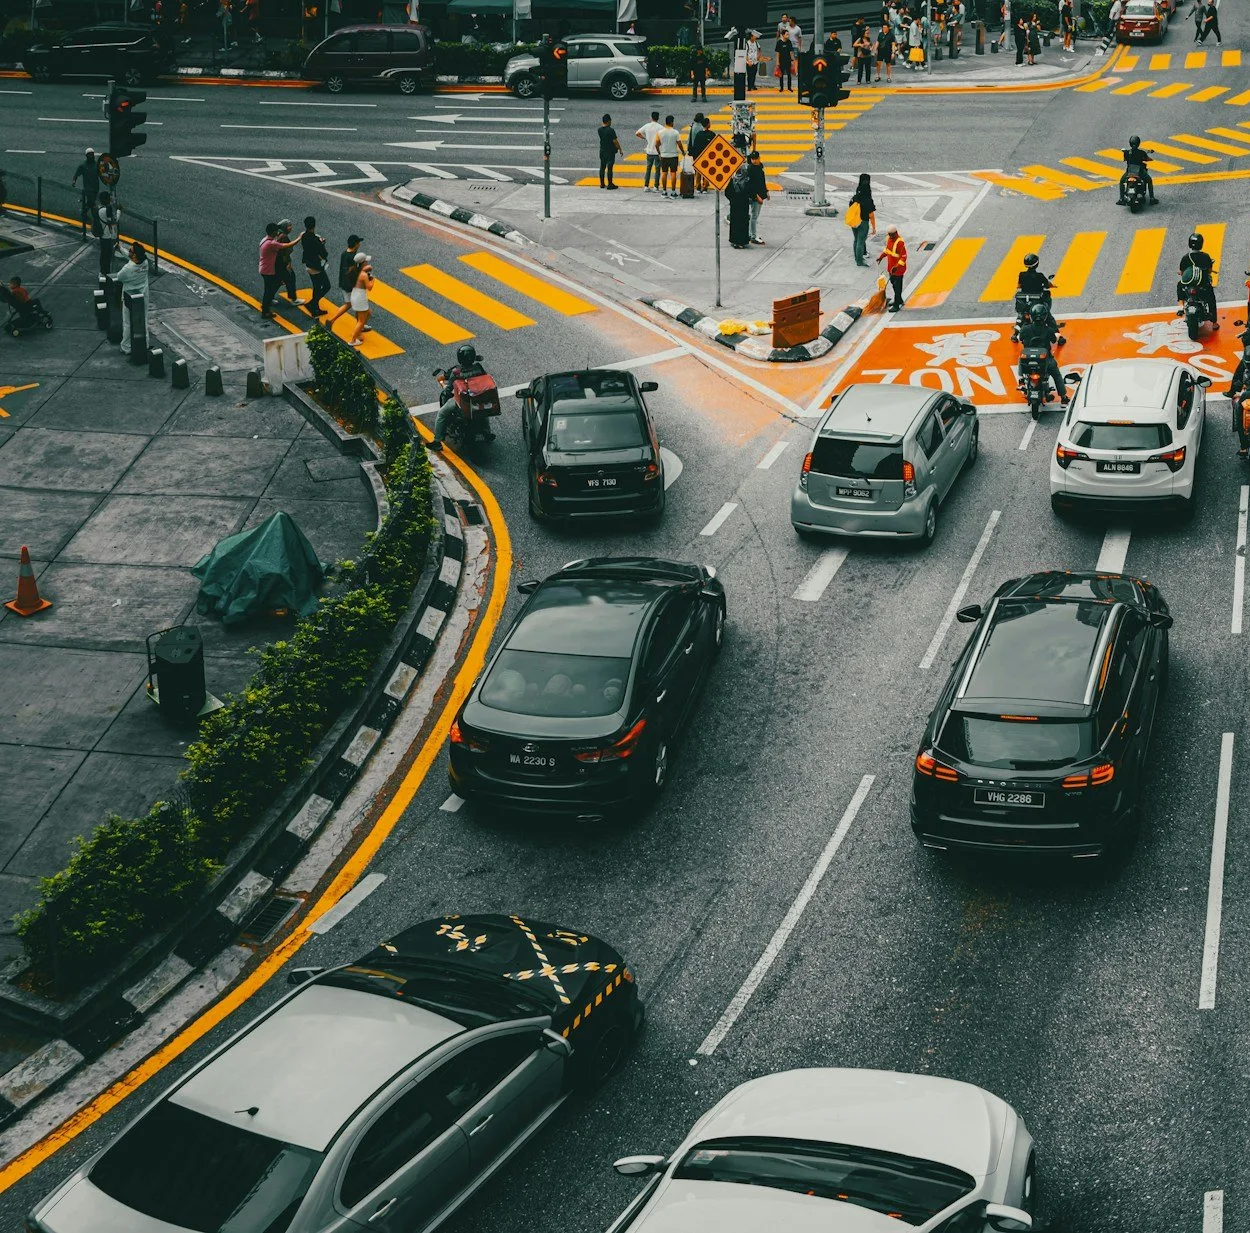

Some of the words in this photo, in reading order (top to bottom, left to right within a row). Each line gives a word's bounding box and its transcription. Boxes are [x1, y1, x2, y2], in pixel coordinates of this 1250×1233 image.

[509, 754, 521, 764] WA
[523, 756, 546, 766] 2230
[549, 758, 556, 767] S
[987, 791, 1006, 802] VHG
[1007, 793, 1032, 804] 2286
